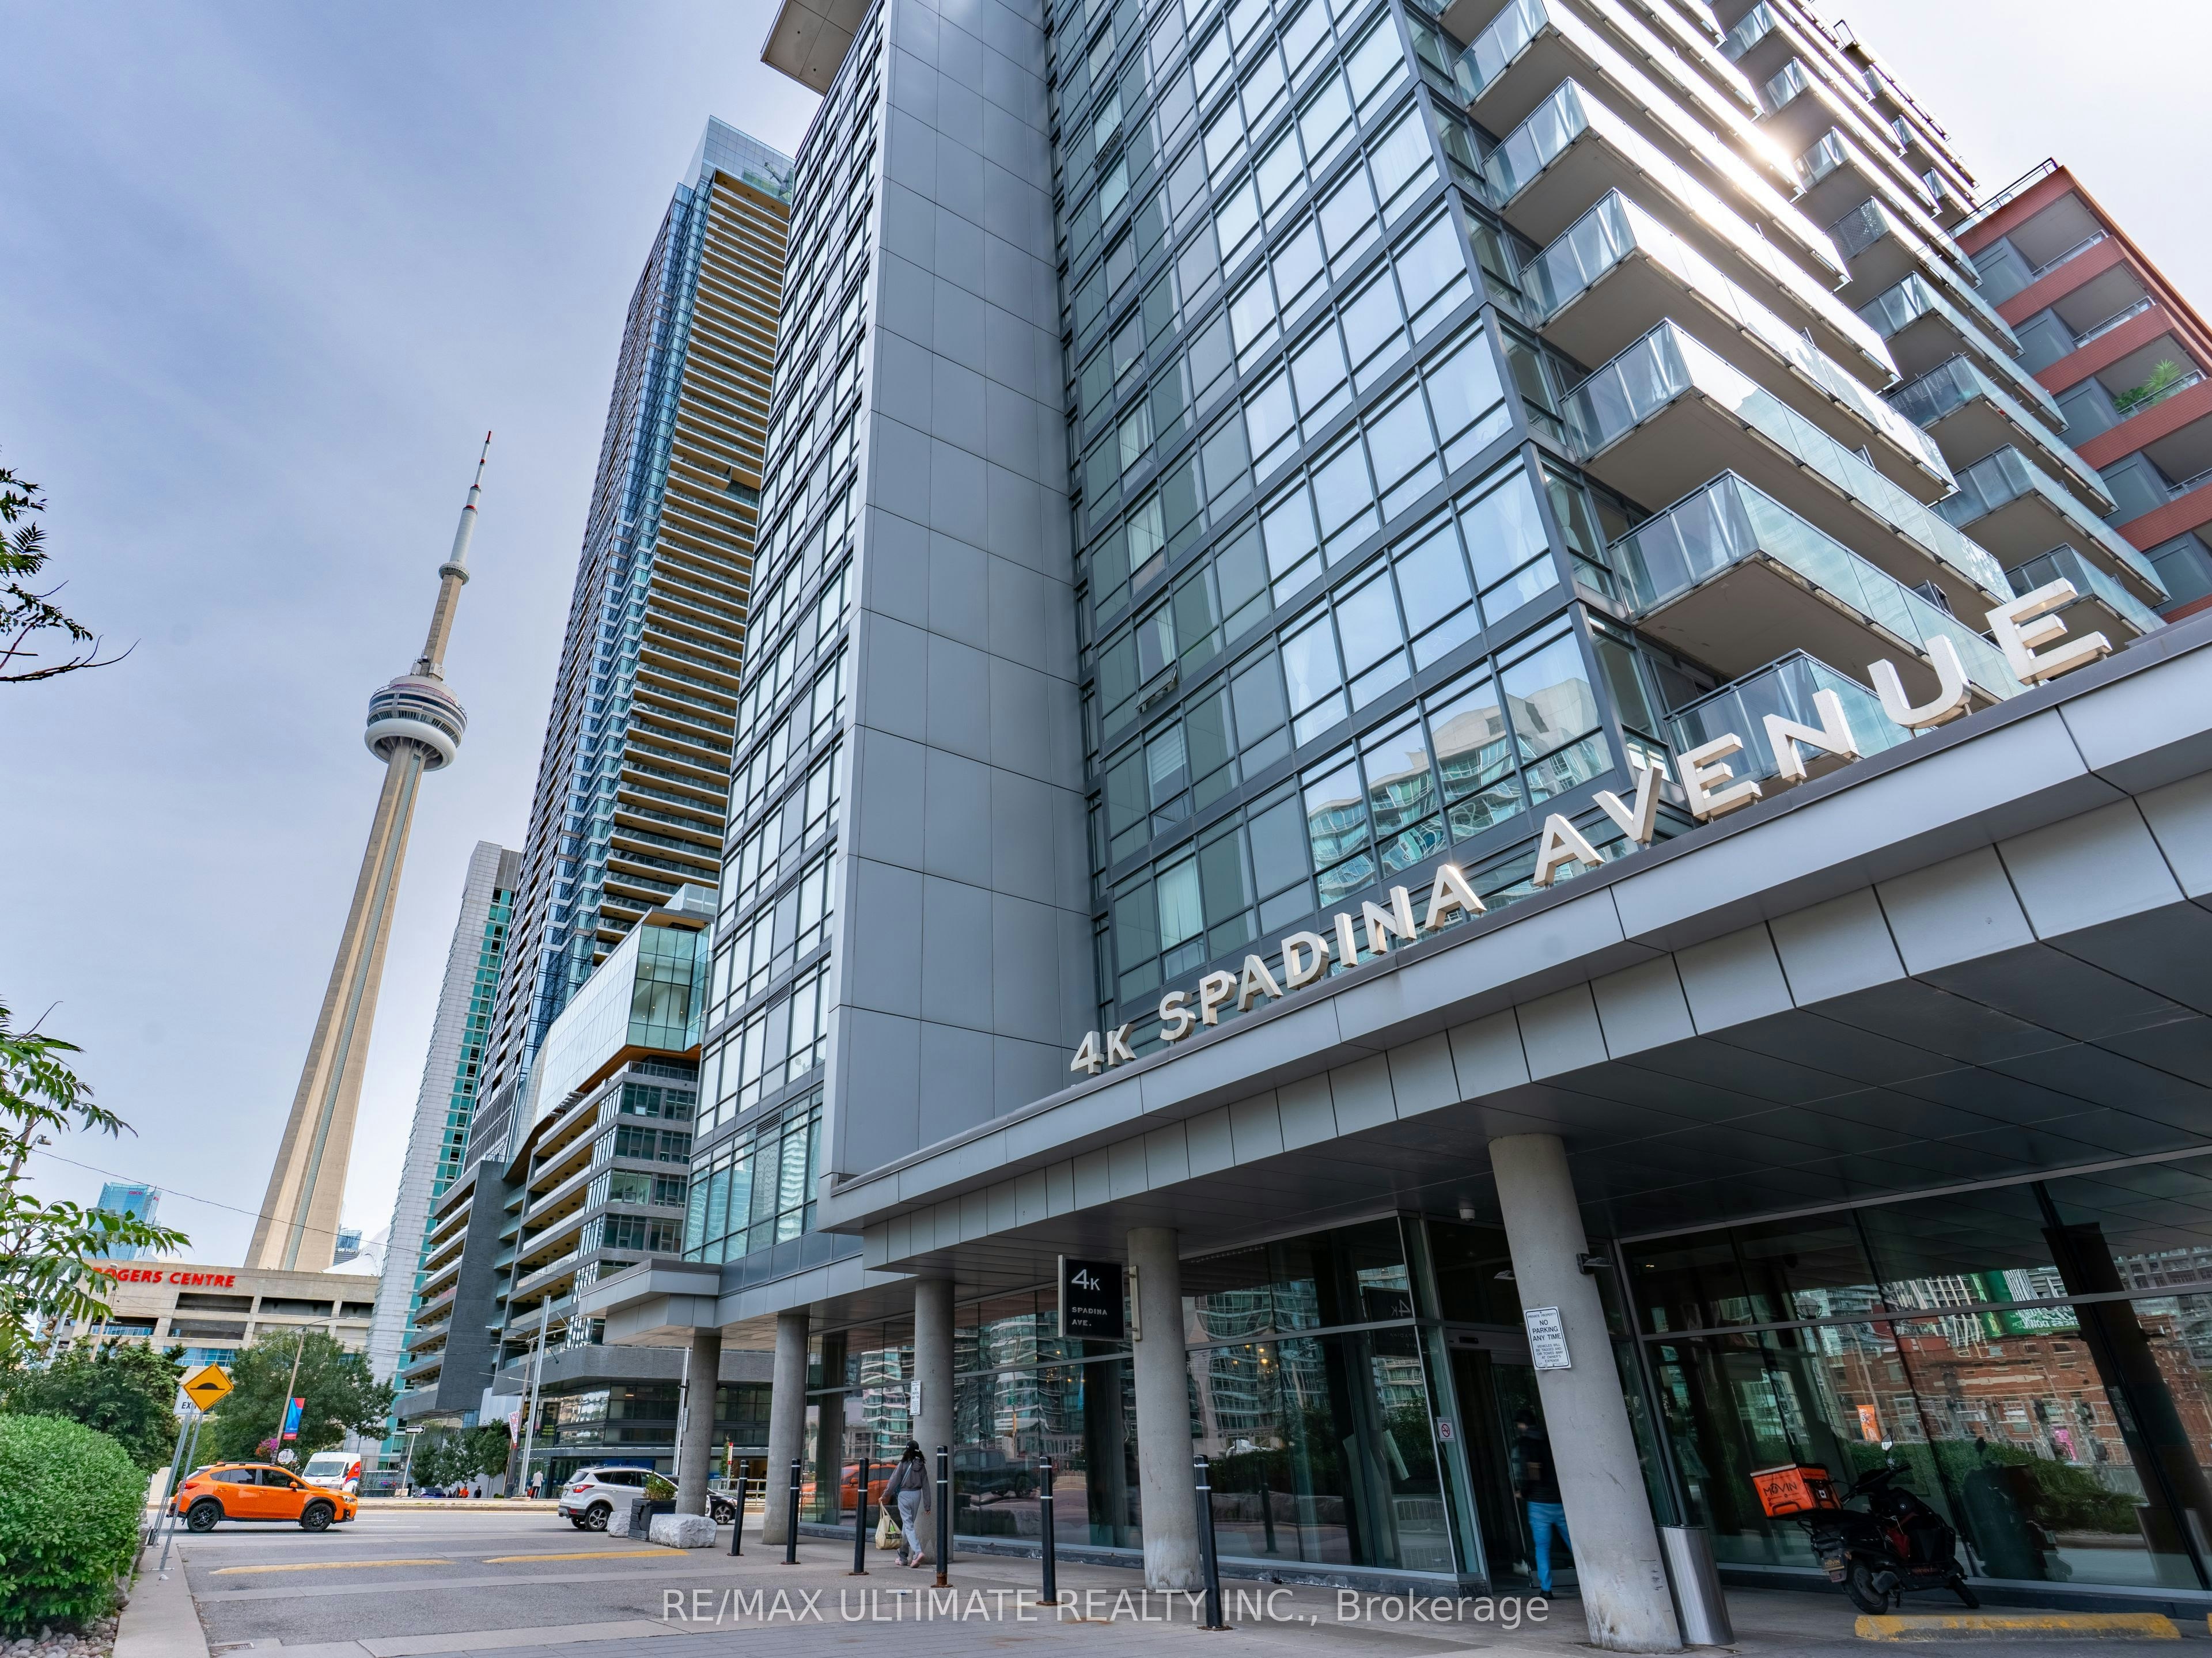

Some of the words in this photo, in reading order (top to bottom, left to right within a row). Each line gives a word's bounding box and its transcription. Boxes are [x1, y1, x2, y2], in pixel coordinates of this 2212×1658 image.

[1071, 1023, 1137, 1075] 4K
[1159, 864, 1487, 1041] SPADINA
[1533, 578, 2112, 885] AVENUE
[170, 1272, 236, 1287] CENTRE
[1071, 1269, 1100, 1291] 4K
[1071, 1307, 1108, 1315] SPADINA
[1763, 1482, 1797, 1496] MOVIN
